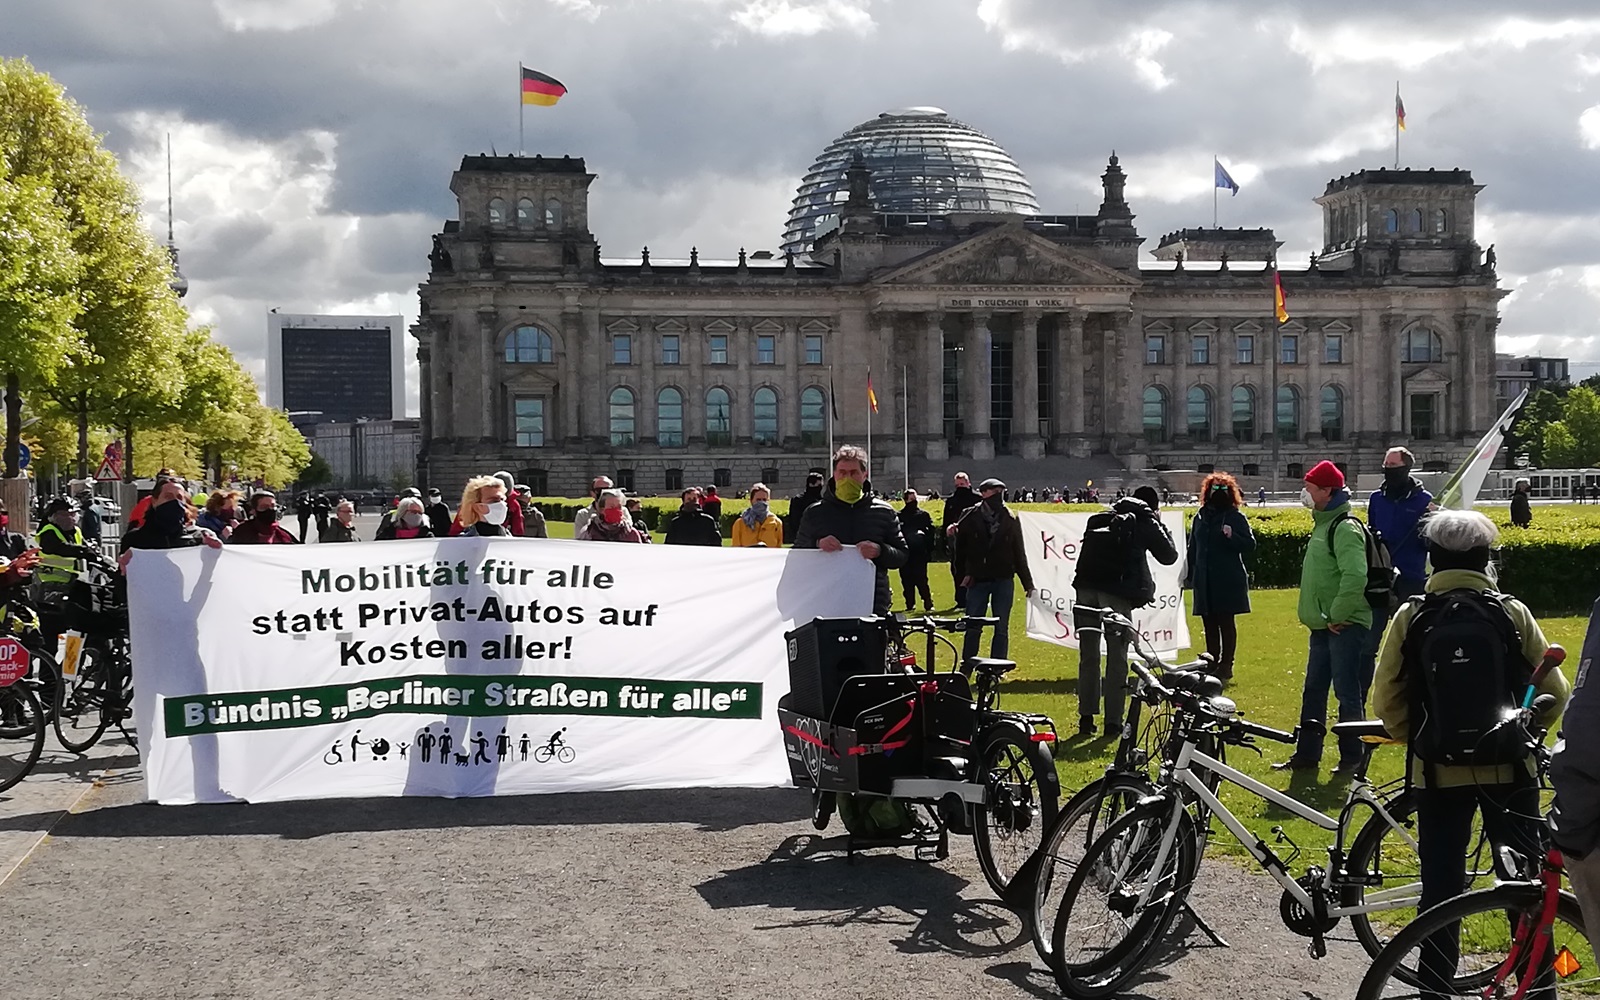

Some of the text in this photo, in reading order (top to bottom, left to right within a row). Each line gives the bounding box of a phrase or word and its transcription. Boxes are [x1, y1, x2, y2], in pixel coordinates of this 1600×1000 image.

[301, 559, 615, 595] Mobilität für alle
[252, 596, 658, 635] statt Privat-Autos auf
[0, 644, 18, 661] OP
[340, 635, 573, 667] Kosten aller!
[183, 680, 747, 727] Bündnis „Berliner Straßen für alle“
